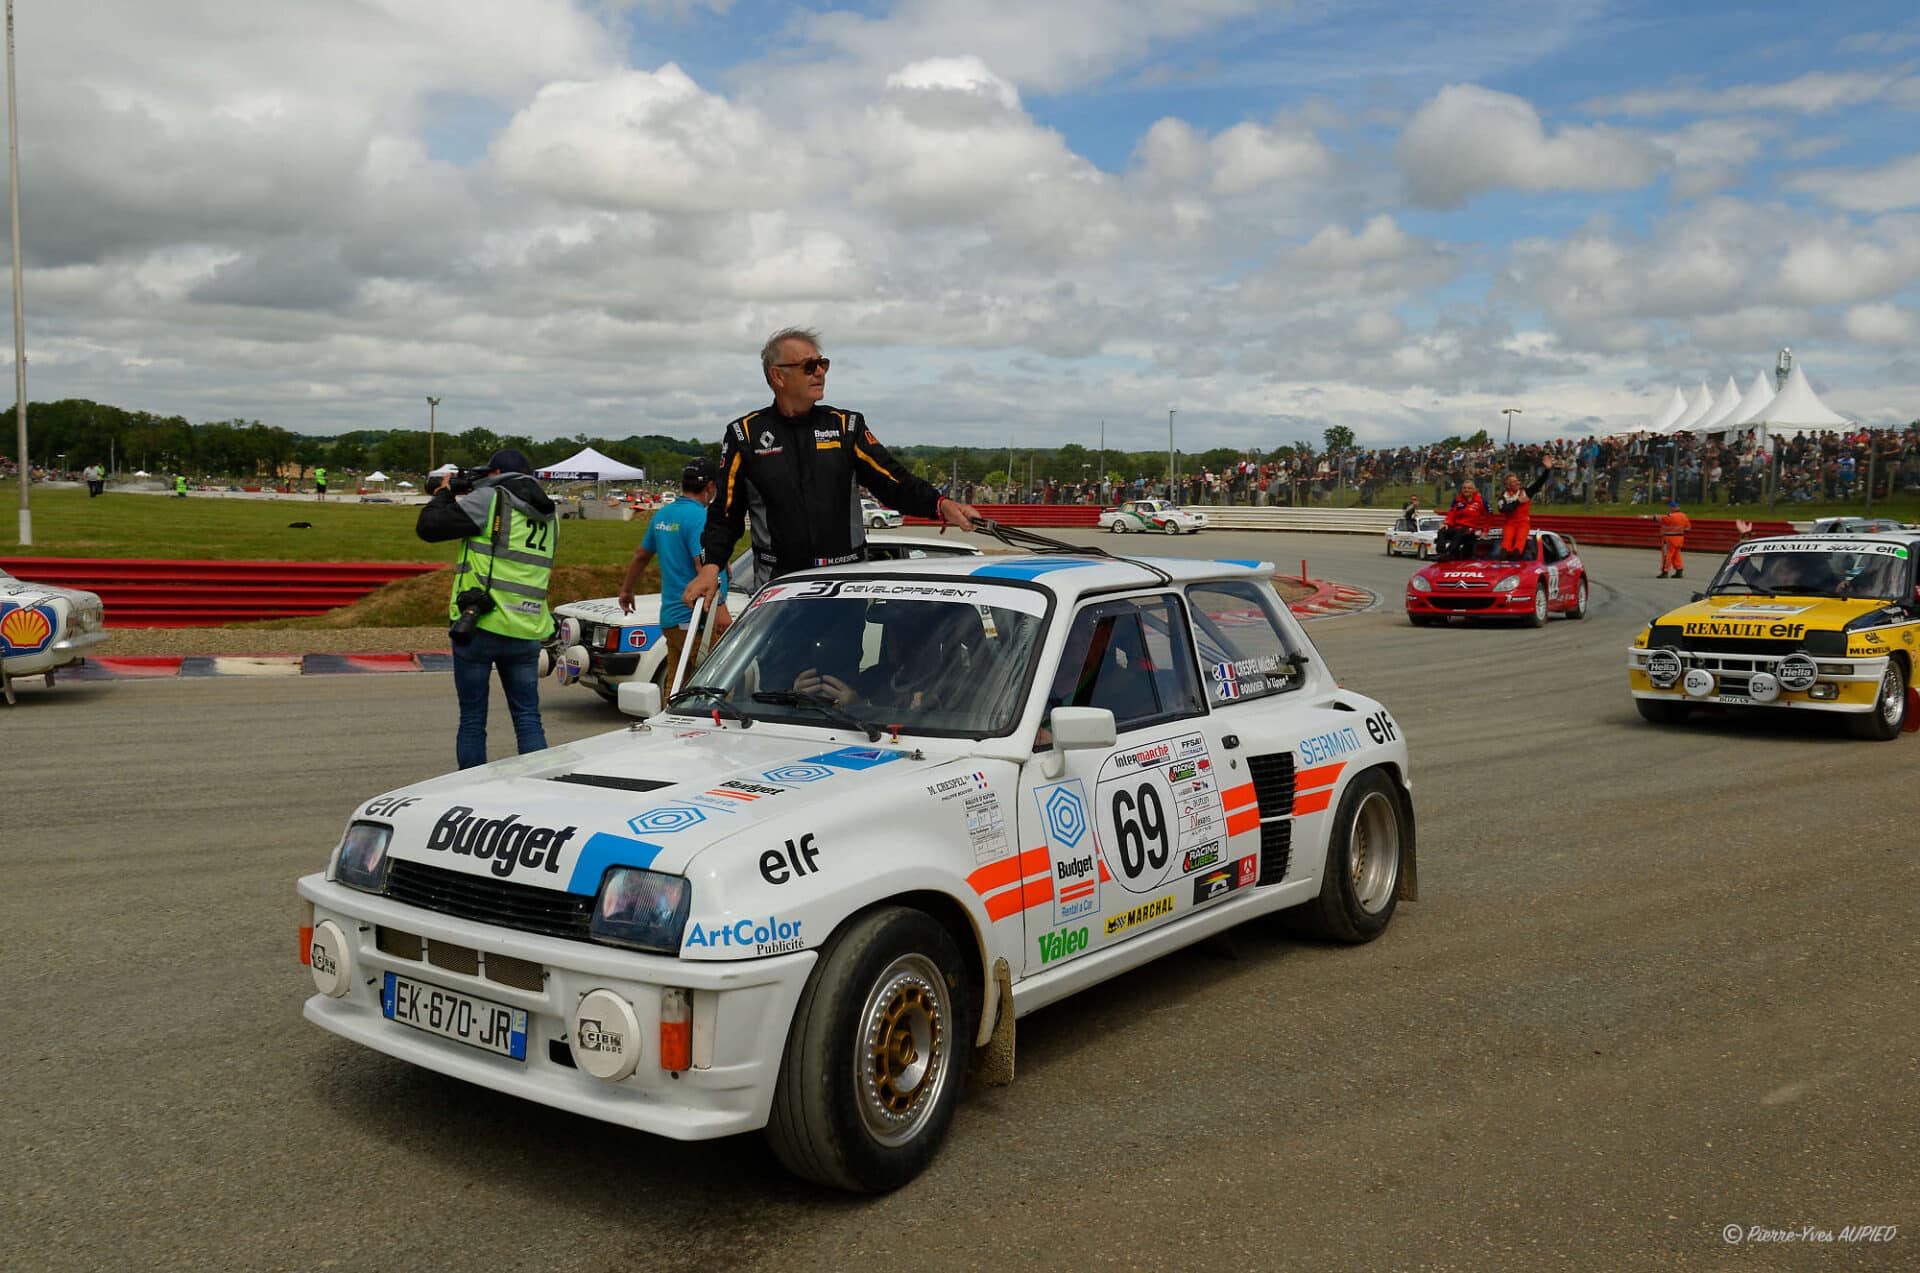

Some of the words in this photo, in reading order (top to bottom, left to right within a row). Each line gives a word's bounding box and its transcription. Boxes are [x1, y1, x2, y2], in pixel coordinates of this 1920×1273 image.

[814, 430, 840, 438] Budget
[525, 519, 548, 552] 22
[1739, 545, 1757, 554] elf
[843, 585, 978, 598] DEVELOPPEMENT
[1685, 623, 1767, 637] RENAULT
[1769, 624, 1806, 638] elf
[1849, 646, 1890, 655] MICHELIN
[1782, 669, 1811, 677] Hella
[1365, 711, 1396, 744] elf
[1300, 728, 1361, 765] SERMATI
[1173, 761, 1196, 775] RACING
[719, 780, 785, 796] Budget
[936, 777, 967, 792] CRESPEL
[364, 797, 423, 818] elf
[1112, 782, 1169, 879] 69
[426, 805, 578, 877] Budget
[1189, 841, 1219, 861] RACING
[759, 833, 820, 885] elf
[1057, 854, 1094, 880] Budget
[1127, 898, 1173, 926] MARCHAL
[685, 916, 802, 948] ArtColor
[757, 938, 804, 955] Publicité
[1038, 926, 1089, 964] Valeo
[386, 1000, 393, 1011] F
[395, 981, 512, 1050] EK-670-JR
